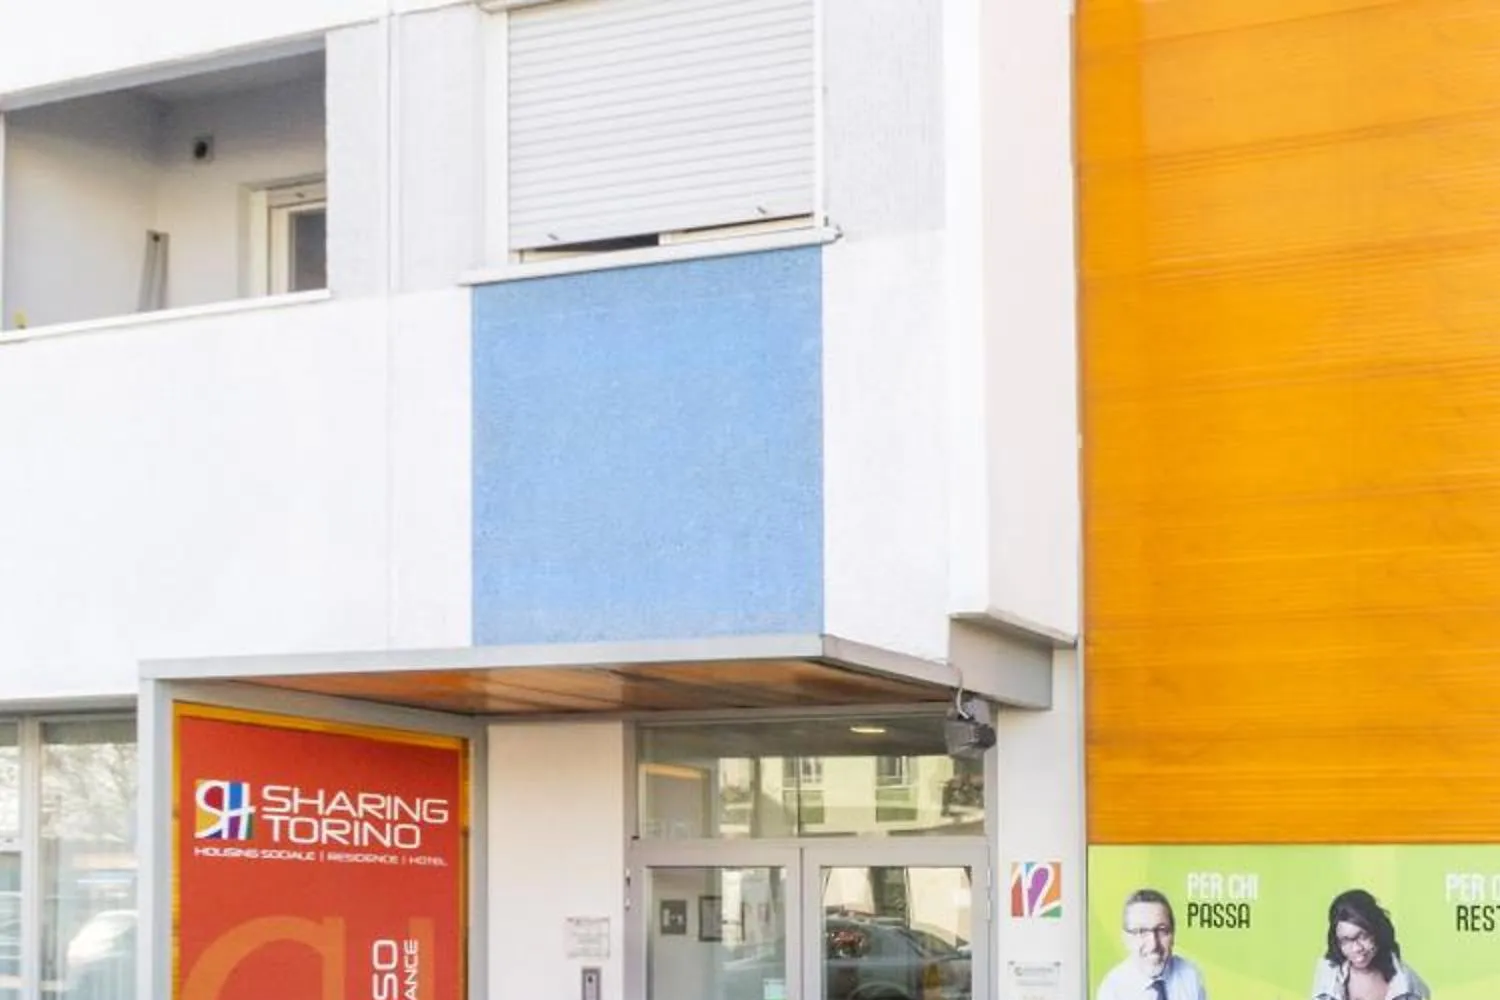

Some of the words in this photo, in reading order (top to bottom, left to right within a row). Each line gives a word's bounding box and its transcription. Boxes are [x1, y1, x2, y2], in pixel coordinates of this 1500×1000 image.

[261, 785, 450, 824] SHARING
[261, 815, 422, 849] TORINO
[194, 846, 259, 858] HOUSING
[261, 849, 316, 861] SOCIALE
[327, 853, 399, 865] RESIDENCE
[408, 856, 448, 866] HOTEL
[1187, 872, 1223, 897] PER
[1228, 874, 1259, 898] CHI
[1445, 872, 1484, 900] PER
[1187, 904, 1251, 930] PASSA
